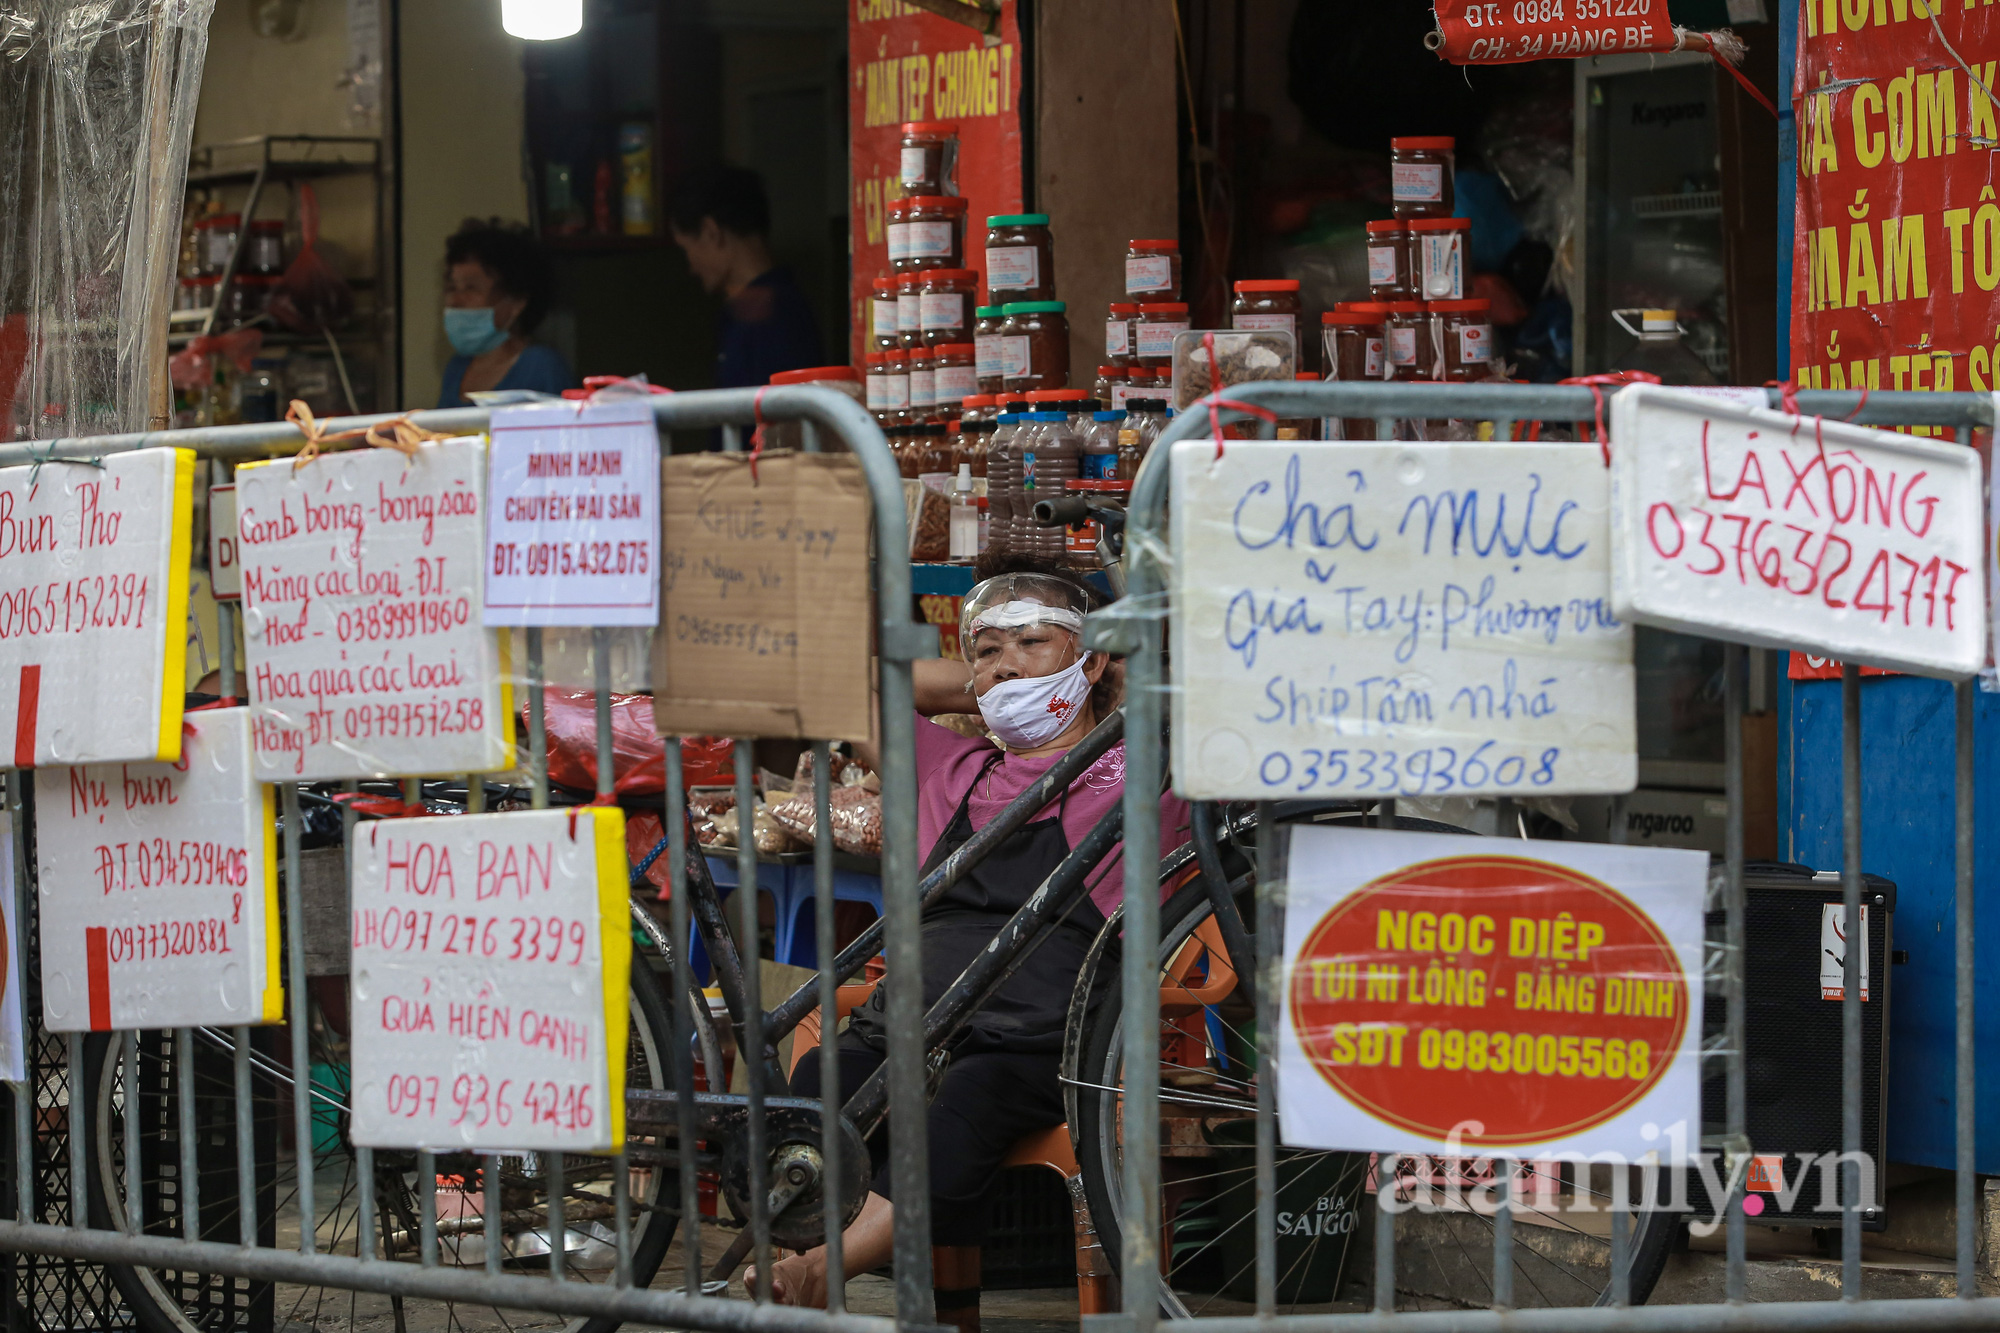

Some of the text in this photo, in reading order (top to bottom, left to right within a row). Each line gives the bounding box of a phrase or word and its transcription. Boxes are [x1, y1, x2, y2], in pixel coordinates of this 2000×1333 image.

[1464, 0, 1650, 28] ĐT: 0984 551220
[1469, 21, 1654, 61] CH: 34 HÀNG BÈ
[1852, 65, 1957, 169] CƠM
[1807, 188, 1929, 313] MẮM
[527, 451, 573, 478] MINH
[379, 470, 434, 547] bóng
[504, 491, 571, 522] CHUYÊN
[608, 482, 642, 520] SẢN
[494, 539, 649, 577] ĐT: 0915.432.675
[245, 563, 309, 622] Măng
[255, 661, 305, 703] Hoa
[359, 649, 403, 693] các
[385, 838, 553, 901] HOA BAN
[507, 915, 587, 967] 3399
[1376, 908, 1606, 970] NGỌC DIỆP
[1310, 952, 1358, 1001] TÚI
[1366, 963, 1400, 1003] NI
[1407, 958, 1487, 1008] LÔNG
[1514, 966, 1597, 1015] BĂNG
[1603, 970, 1676, 1019] DÍNH
[518, 1008, 589, 1062] OANH
[1331, 1021, 1652, 1081] SĐT 0983005568
[386, 1072, 440, 1119] 097
[1316, 1196, 1346, 1211] BIA
